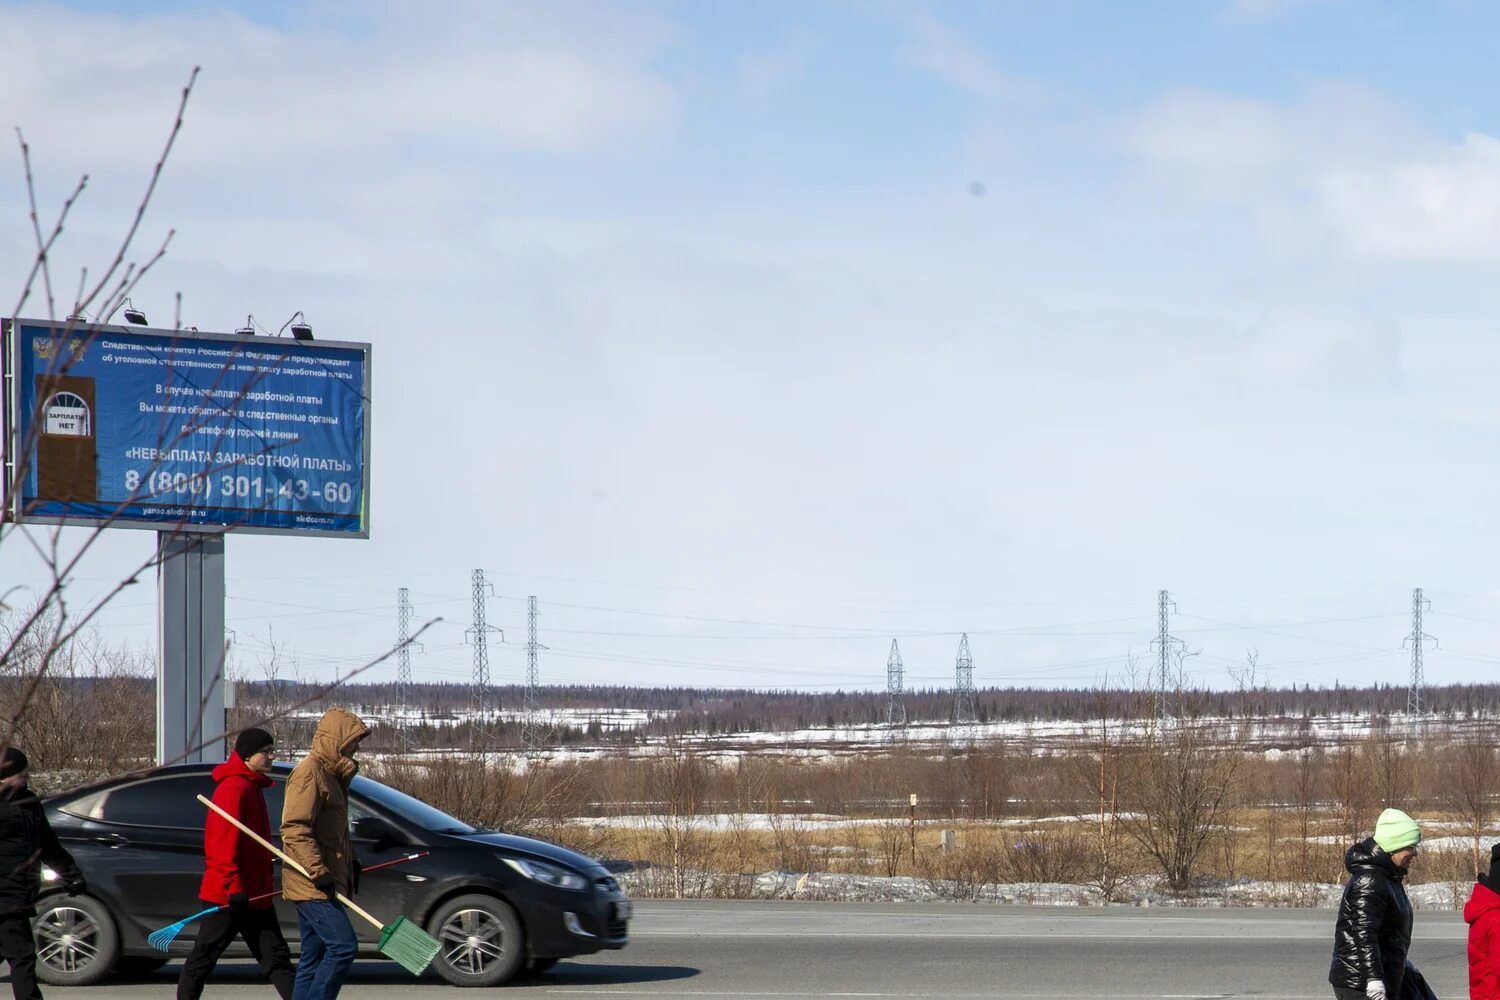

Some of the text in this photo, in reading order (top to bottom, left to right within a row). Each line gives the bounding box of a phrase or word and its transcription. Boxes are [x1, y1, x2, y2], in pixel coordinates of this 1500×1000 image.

[102, 353, 113, 362] об
[114, 355, 157, 366] уголовной
[282, 367, 327, 377] заработной
[245, 351, 290, 361] Федераци
[155, 383, 162, 394] В
[164, 386, 194, 397] случае
[246, 391, 295, 402] заработной
[296, 395, 323, 405] платы
[139, 401, 154, 412] Вы
[155, 404, 187, 414] можете
[238, 410, 245, 418] в
[246, 410, 306, 422] следственные
[308, 414, 338, 425] органы
[237, 428, 271, 439] горячей
[272, 431, 299, 440] линии
[125, 447, 352, 472] «НЕВЫПЛАТА ЗАРАБОТНОЙ ПЛАТЫ»
[125, 469, 140, 492] 8
[149, 470, 212, 500] (800)
